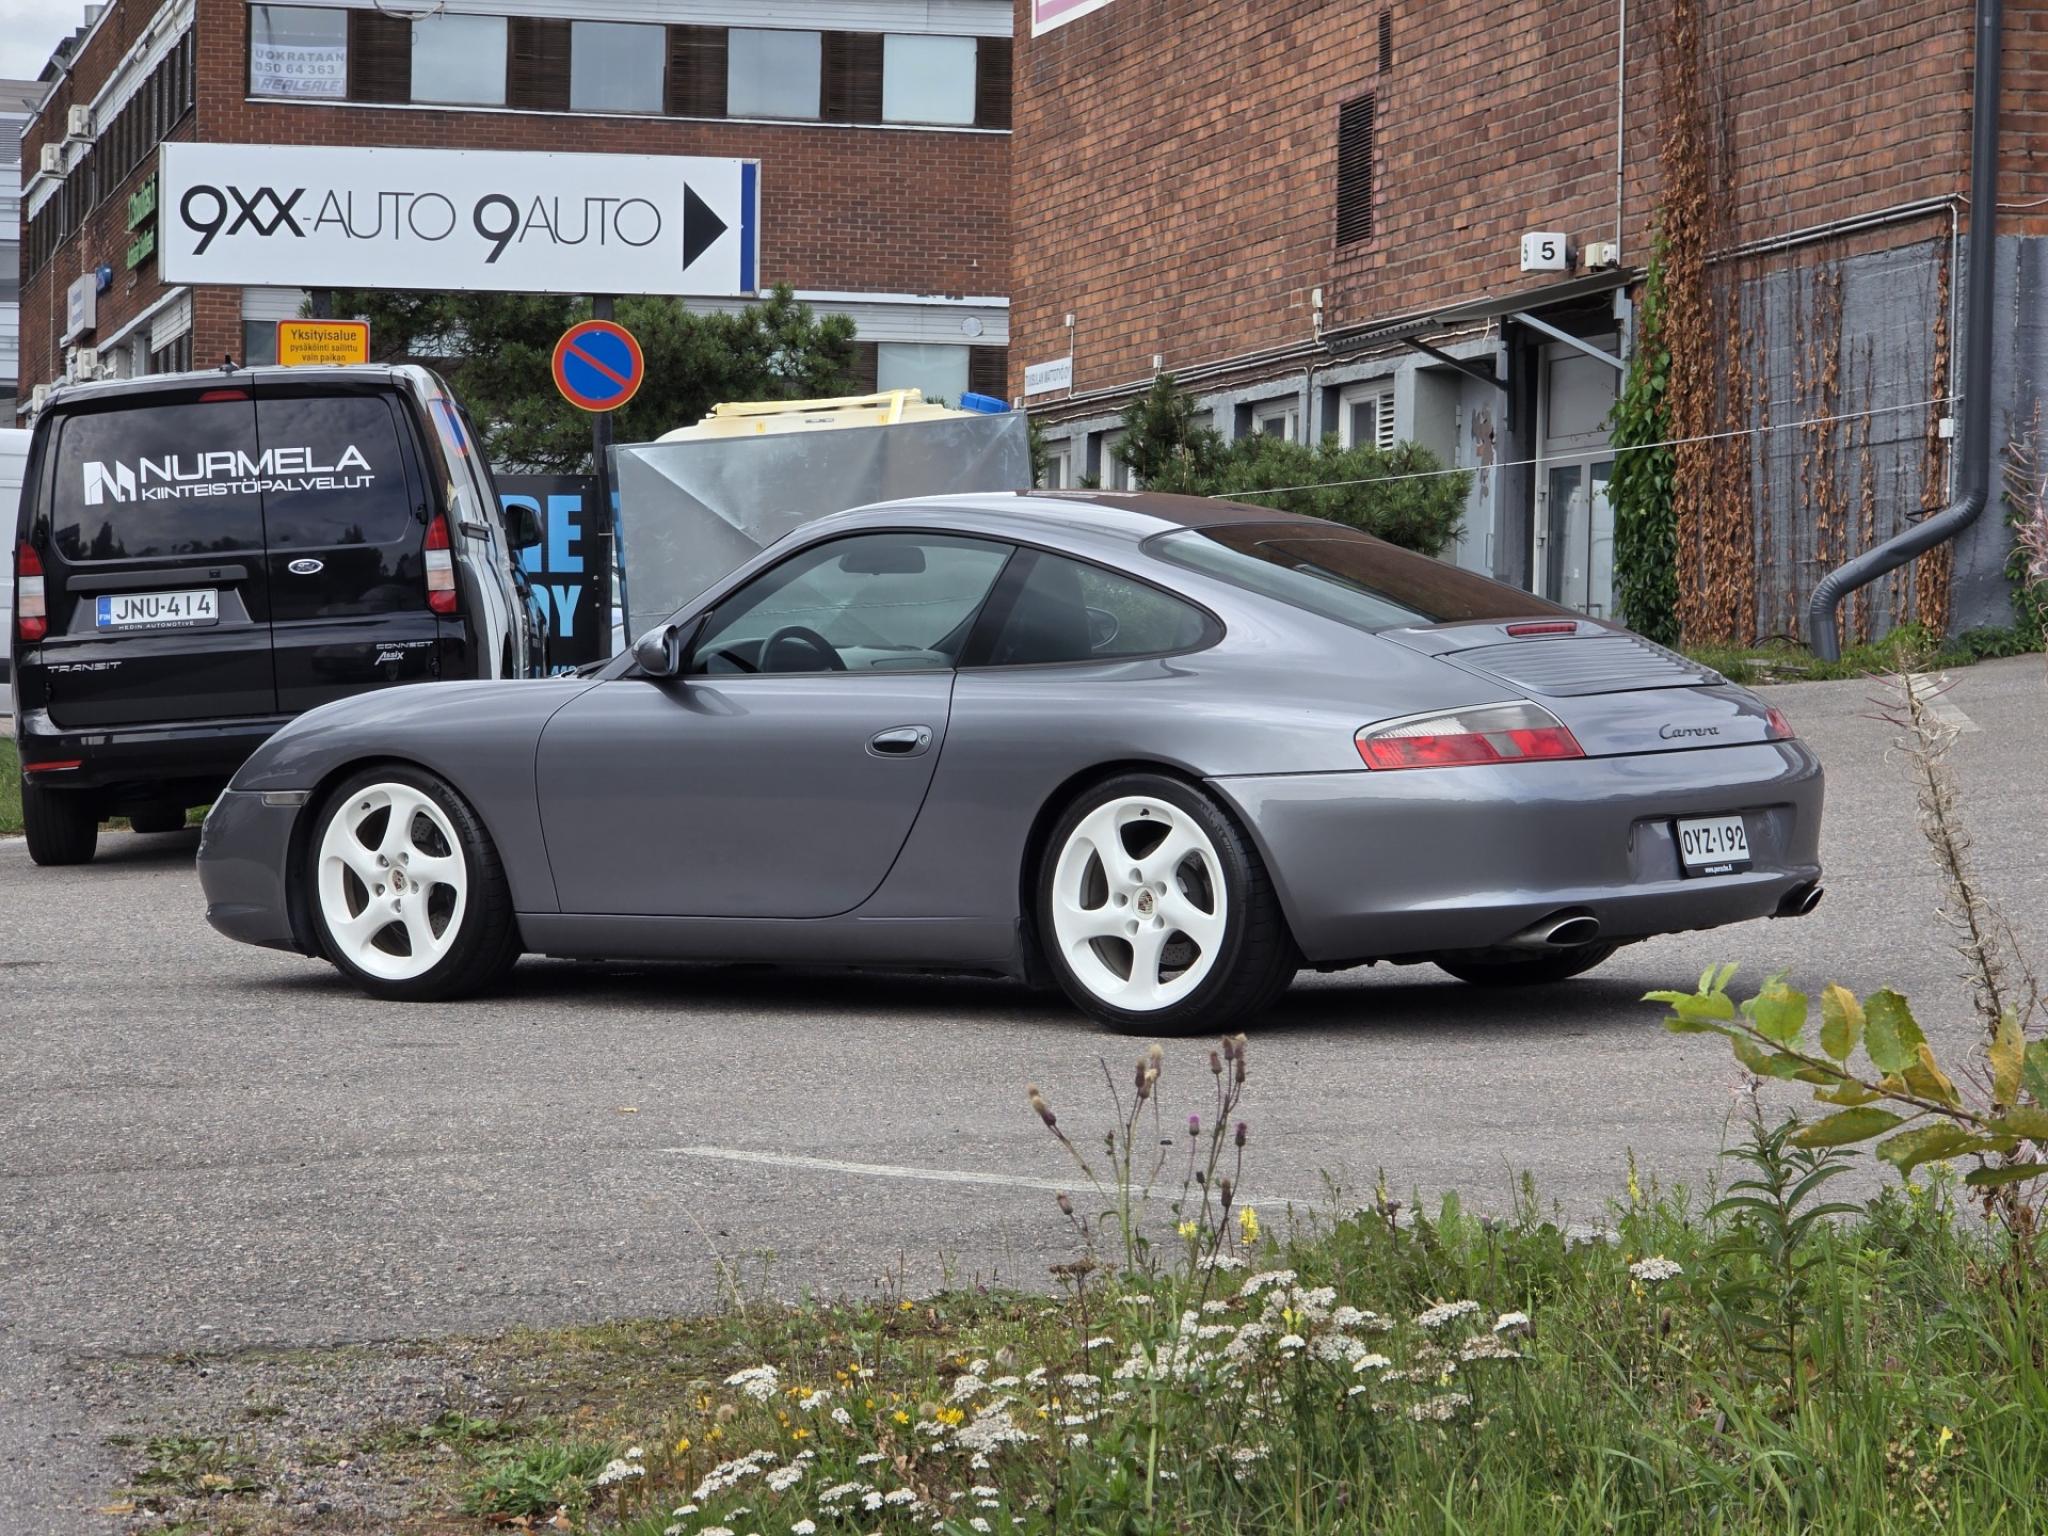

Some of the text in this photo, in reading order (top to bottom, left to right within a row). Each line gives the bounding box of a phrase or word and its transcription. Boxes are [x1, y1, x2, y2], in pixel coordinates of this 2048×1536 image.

[1541, 241, 1555, 260] 5
[291, 329, 357, 342] Yksityisalue
[140, 445, 372, 483] NURMELA
[142, 475, 375, 500] KIINTEISTÖPALVELUT
[146, 621, 195, 629] AUTOMOTIVE
[376, 641, 433, 650] CONNECT
[47, 661, 122, 673] TRANSIT
[1659, 723, 1720, 740] Carrera
[1683, 825, 1746, 855] OYZ-192
